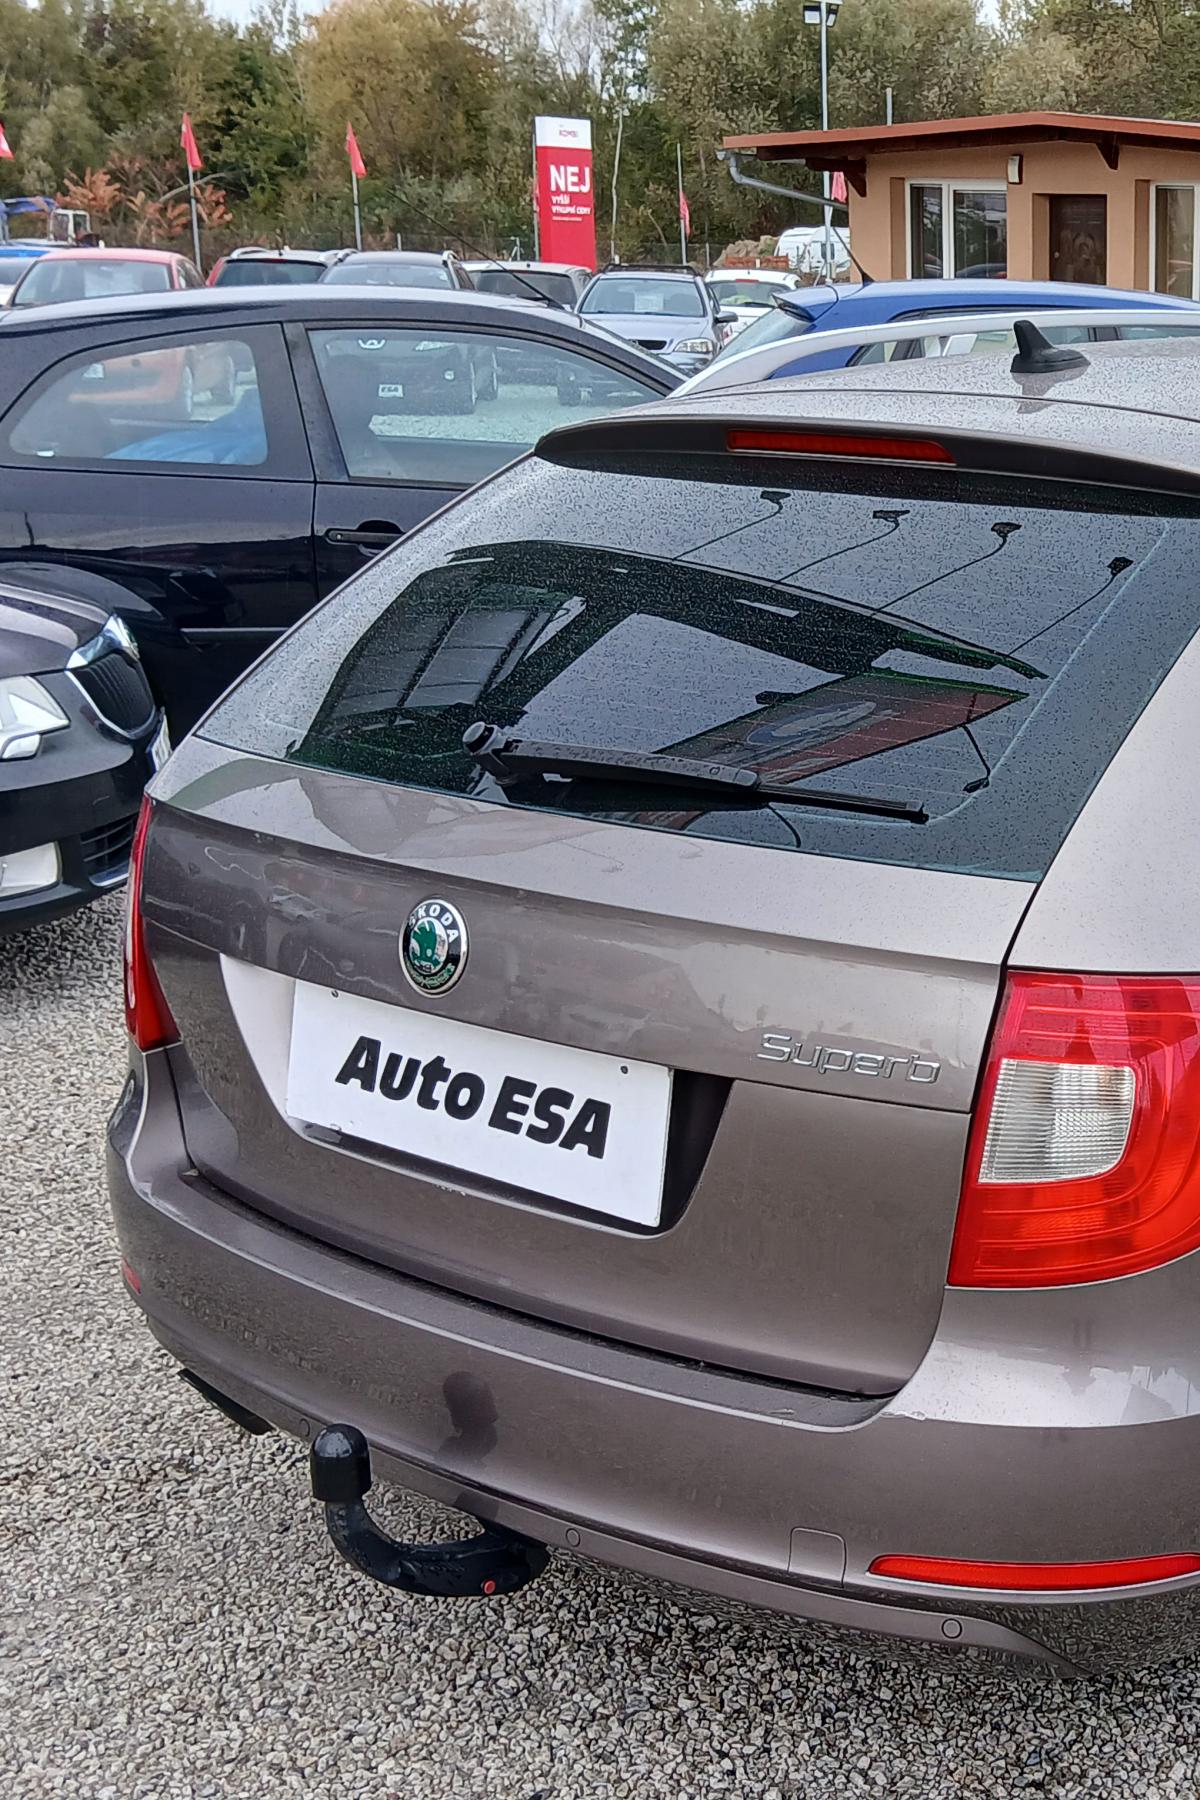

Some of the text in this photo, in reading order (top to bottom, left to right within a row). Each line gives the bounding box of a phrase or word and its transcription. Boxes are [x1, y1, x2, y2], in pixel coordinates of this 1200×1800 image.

[549, 164, 591, 193] NEJ
[756, 1032, 943, 1085] Superb
[334, 1035, 612, 1160] Auto ESA
